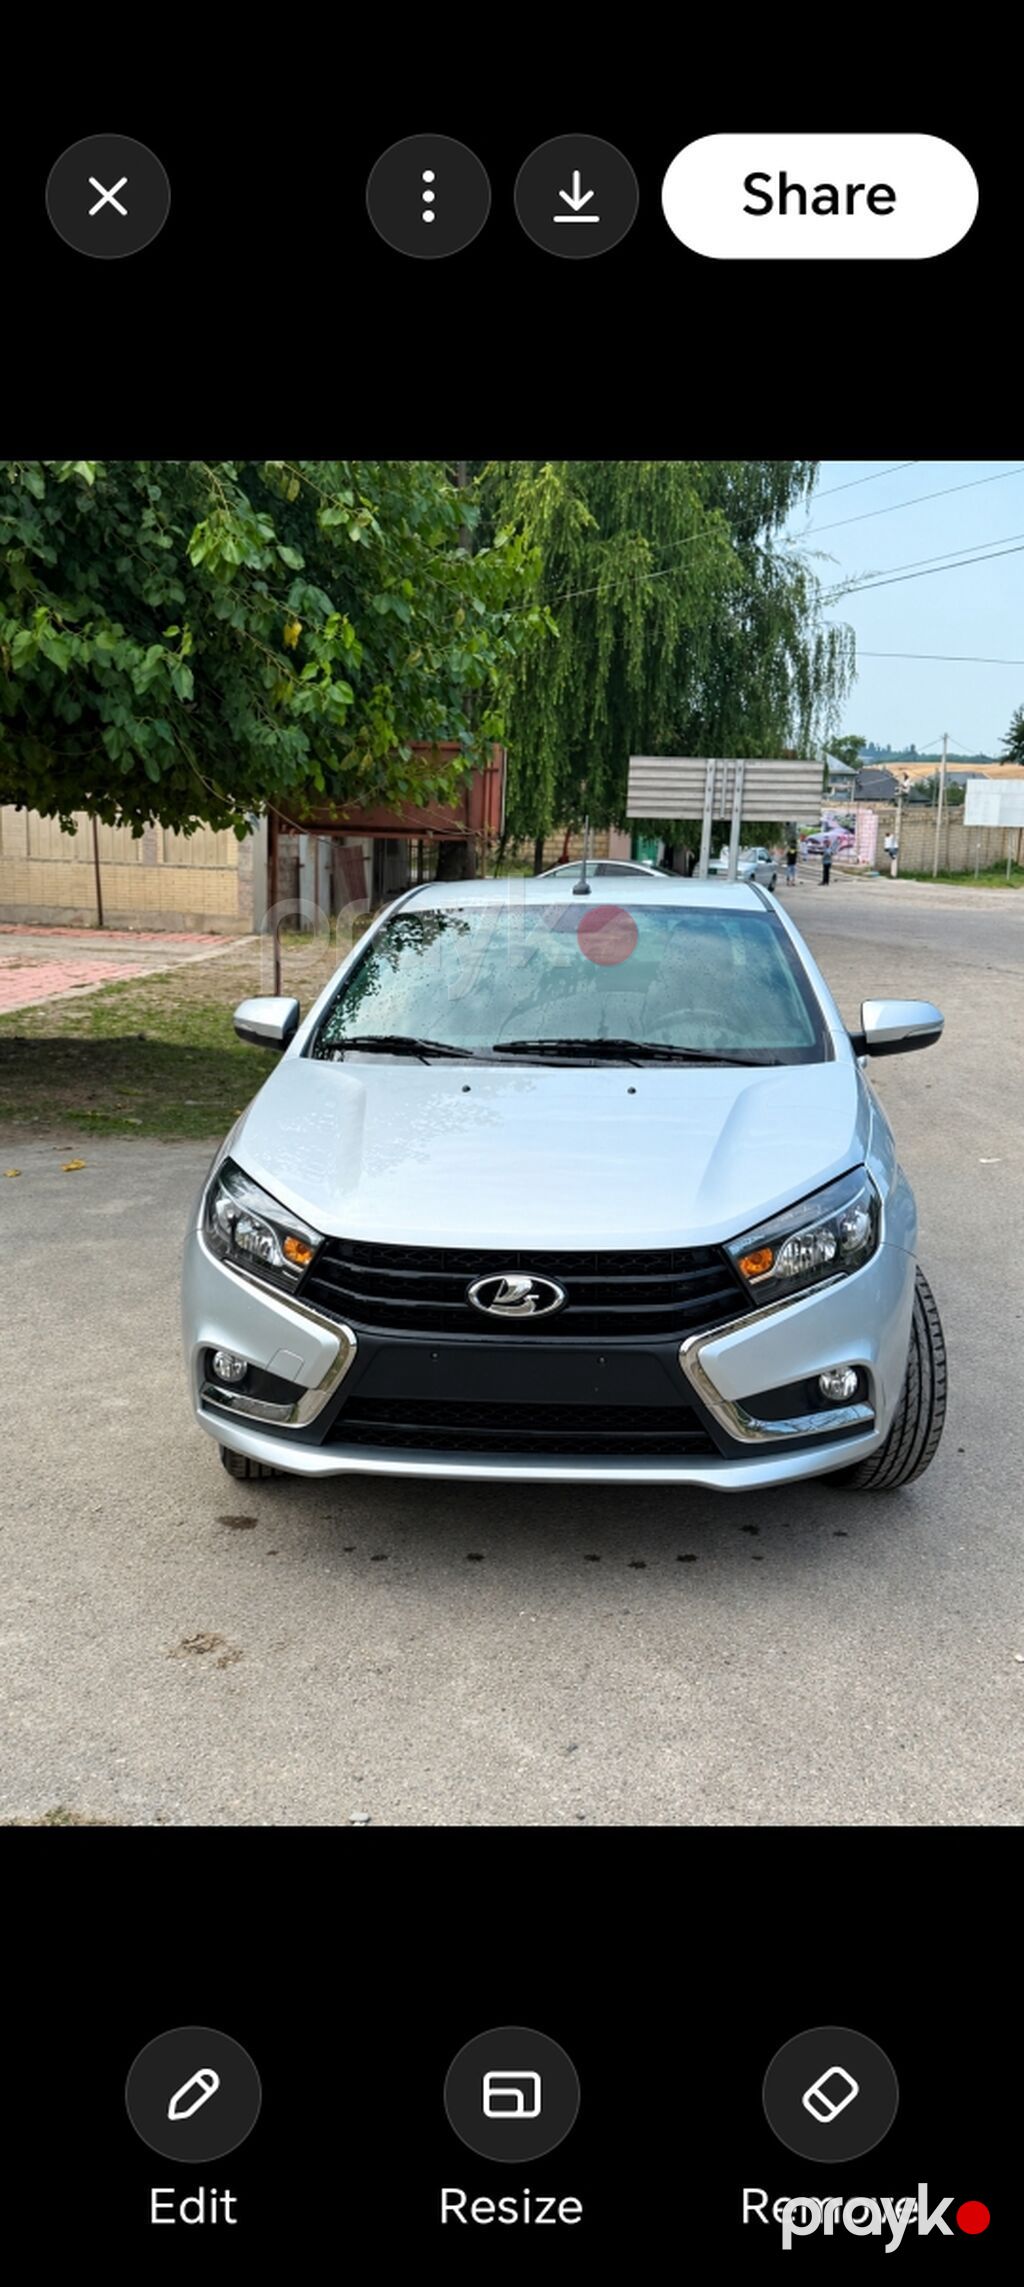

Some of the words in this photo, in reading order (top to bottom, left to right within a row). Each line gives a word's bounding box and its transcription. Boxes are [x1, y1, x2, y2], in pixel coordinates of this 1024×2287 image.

[743, 171, 896, 216] Share
[151, 2186, 238, 2225] Edit
[441, 2187, 583, 2225] Resize
[742, 2187, 918, 2225] Remoe
